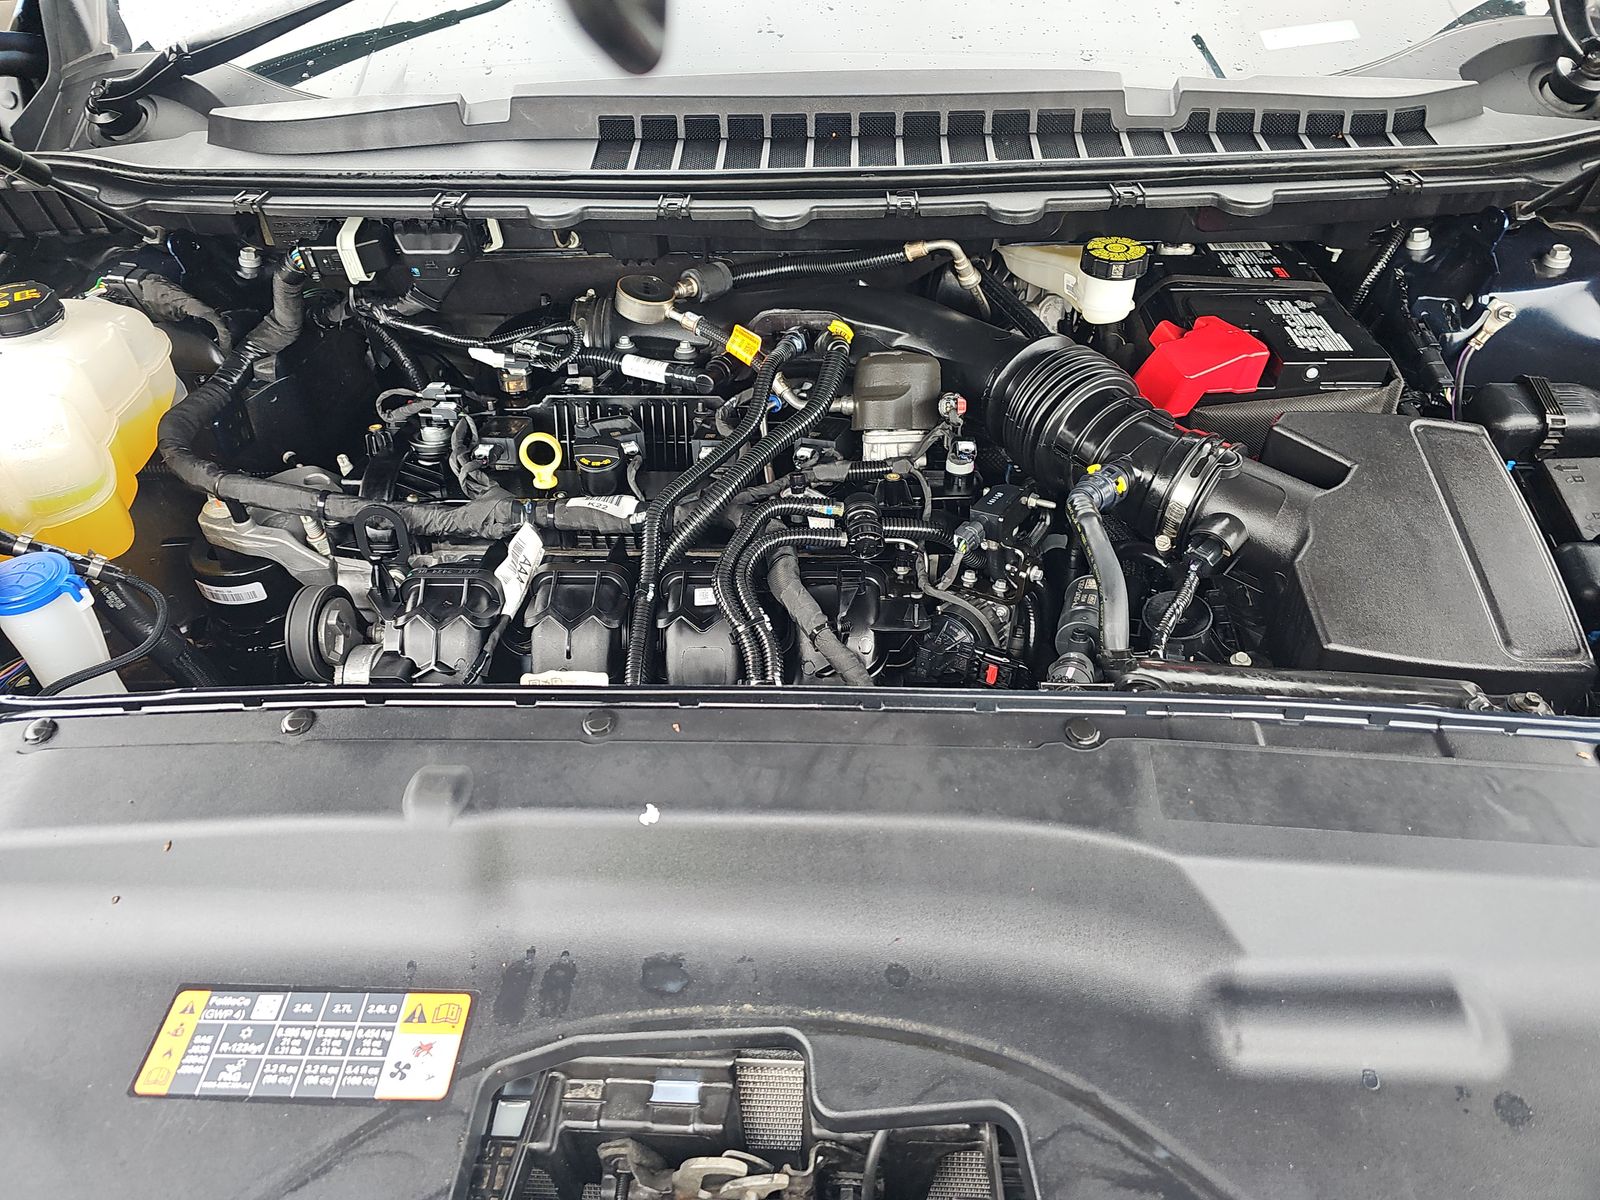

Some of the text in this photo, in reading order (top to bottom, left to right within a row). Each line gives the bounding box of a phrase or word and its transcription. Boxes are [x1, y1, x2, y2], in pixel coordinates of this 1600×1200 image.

[587, 502, 609, 510] K22
[201, 1008, 246, 1021] (GWP 4)
